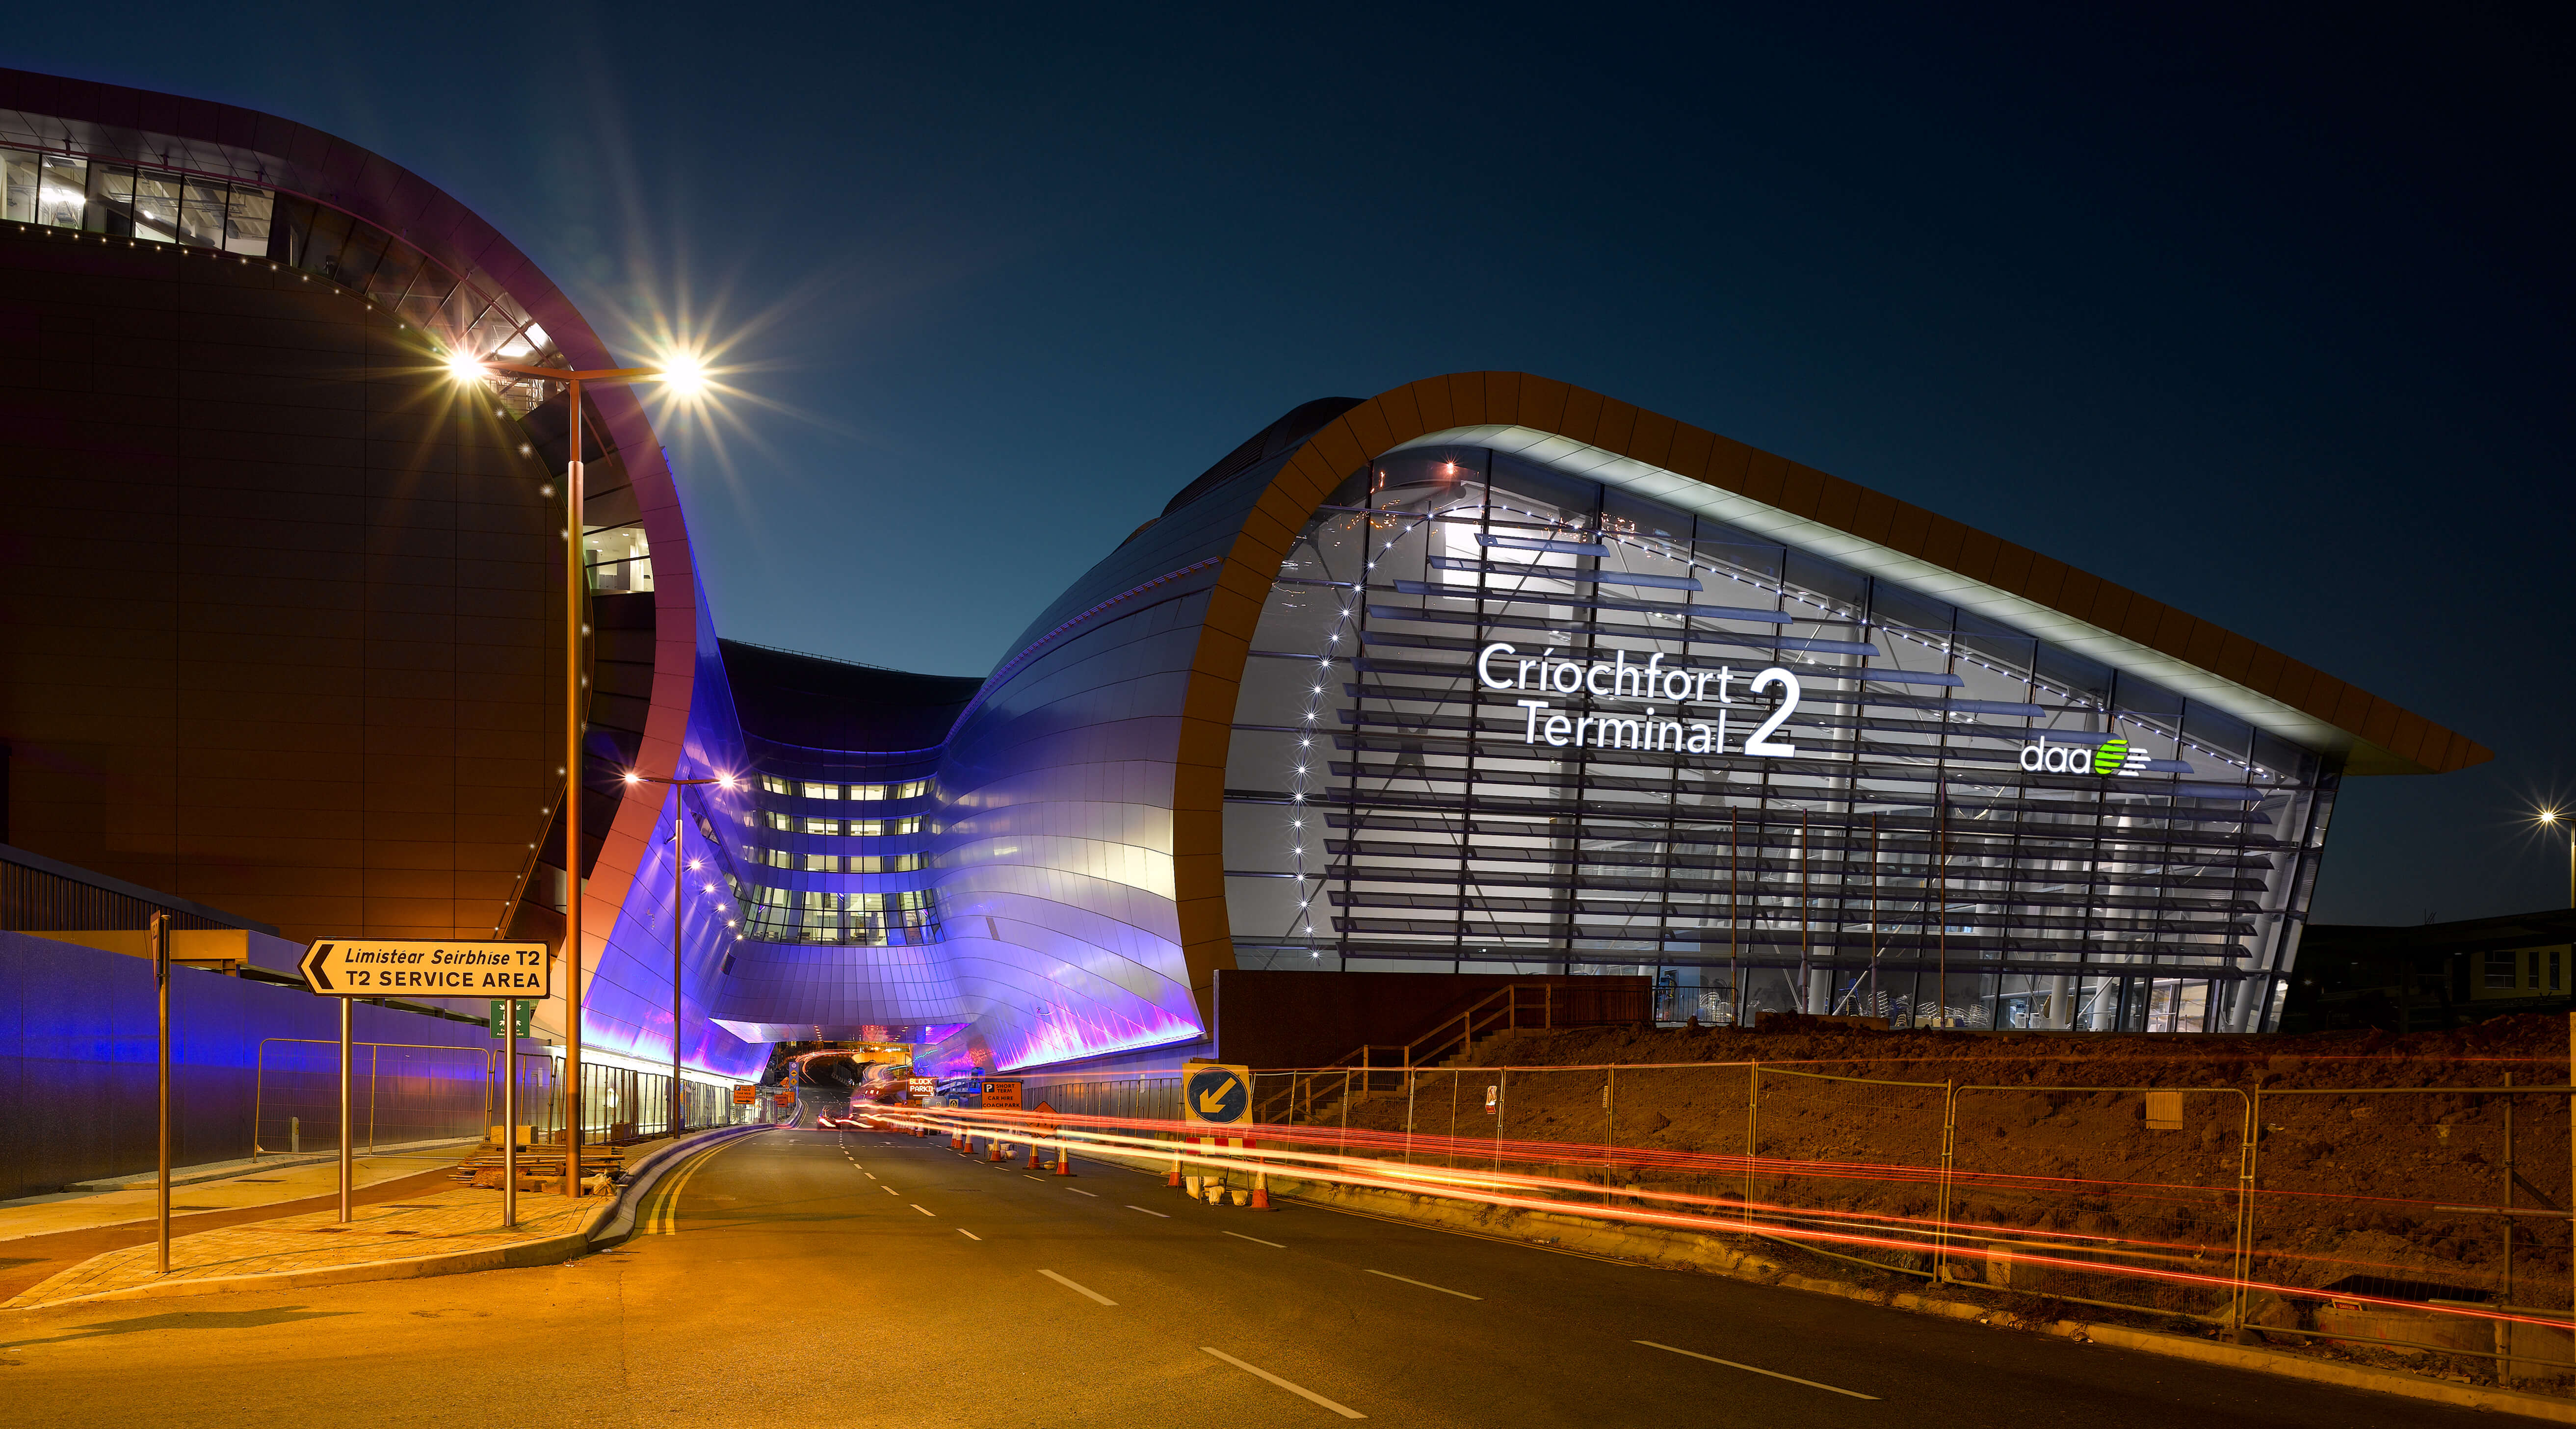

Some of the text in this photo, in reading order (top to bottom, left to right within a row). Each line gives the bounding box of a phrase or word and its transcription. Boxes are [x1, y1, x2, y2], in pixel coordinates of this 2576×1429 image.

[1478, 643, 1733, 704] Críochfort
[1517, 700, 1727, 754] Terminal
[1744, 667, 1801, 757] 2
[2020, 736, 2091, 774] daa
[345, 948, 540, 966] Limistéar Seirbhíse T2
[346, 970, 540, 987] T2 SERVICE AREA
